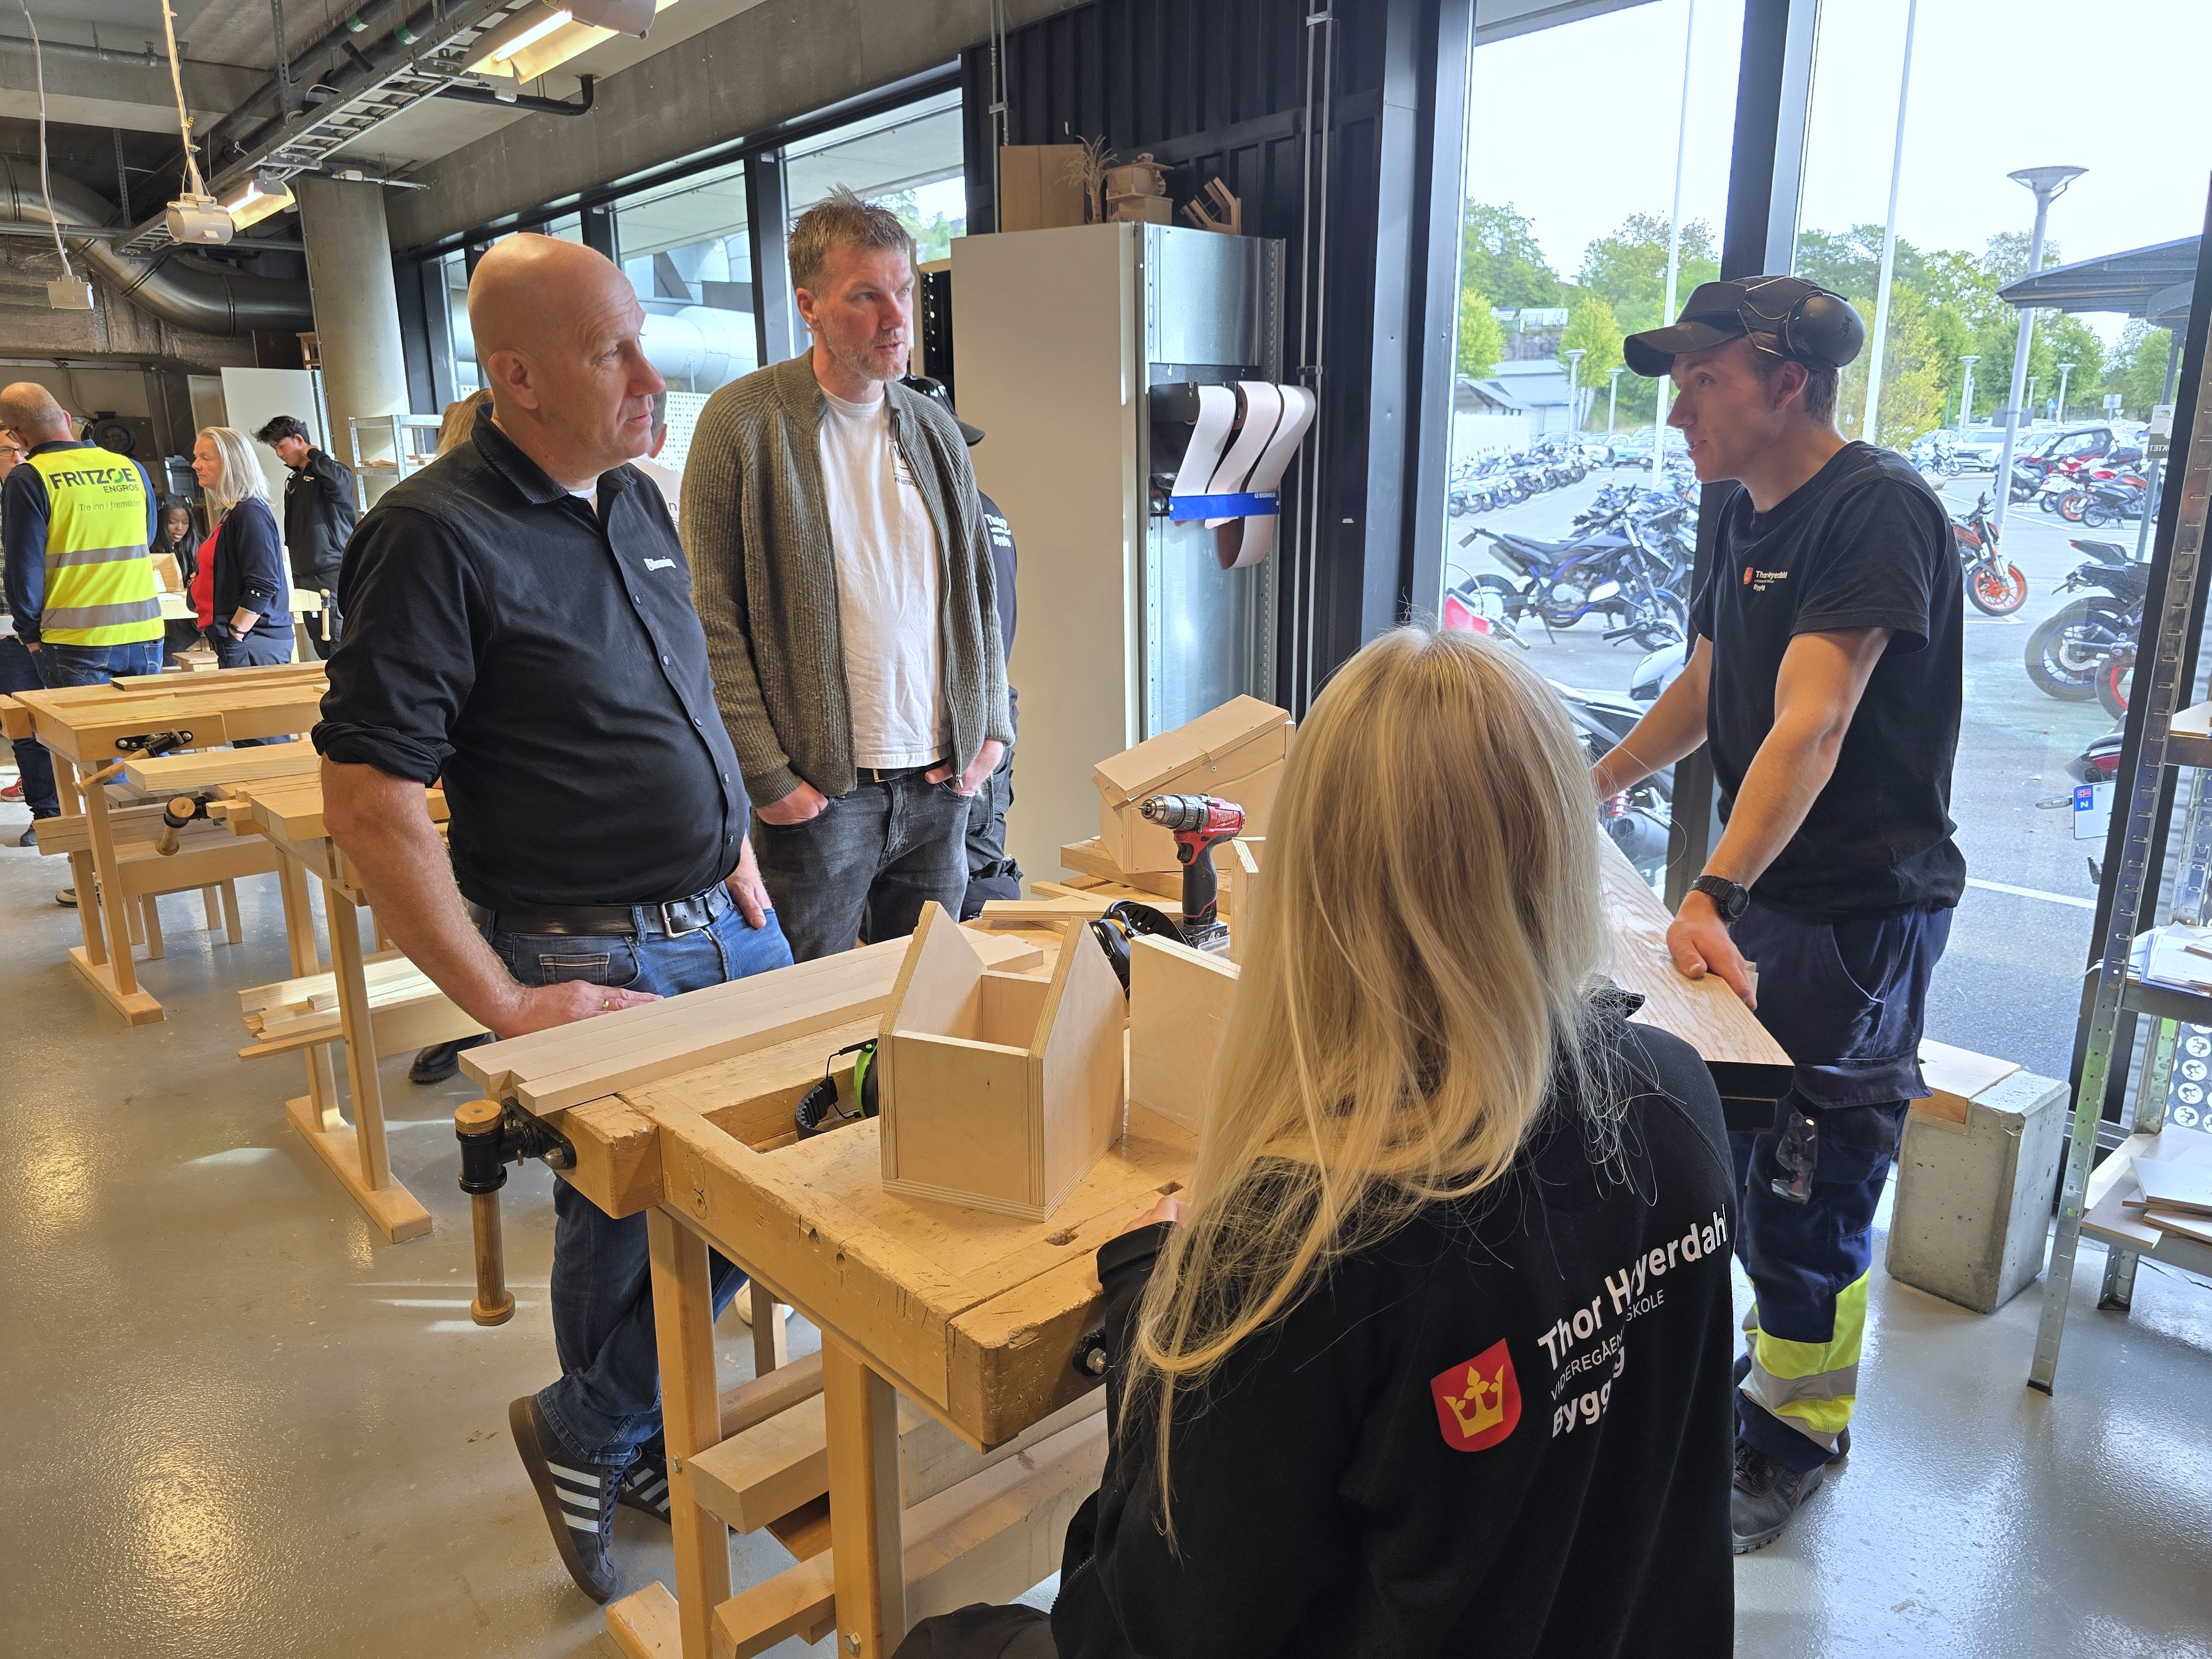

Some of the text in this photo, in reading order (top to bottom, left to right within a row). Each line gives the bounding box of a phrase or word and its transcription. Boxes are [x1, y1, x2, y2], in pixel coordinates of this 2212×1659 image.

[103, 484, 139, 493] ENGROS
[79, 503, 91, 512] Tre
[93, 502, 104, 510] inn
[110, 499, 141, 510] fremtiden
[1537, 1203, 1728, 1370] Thor Hyerdahl
